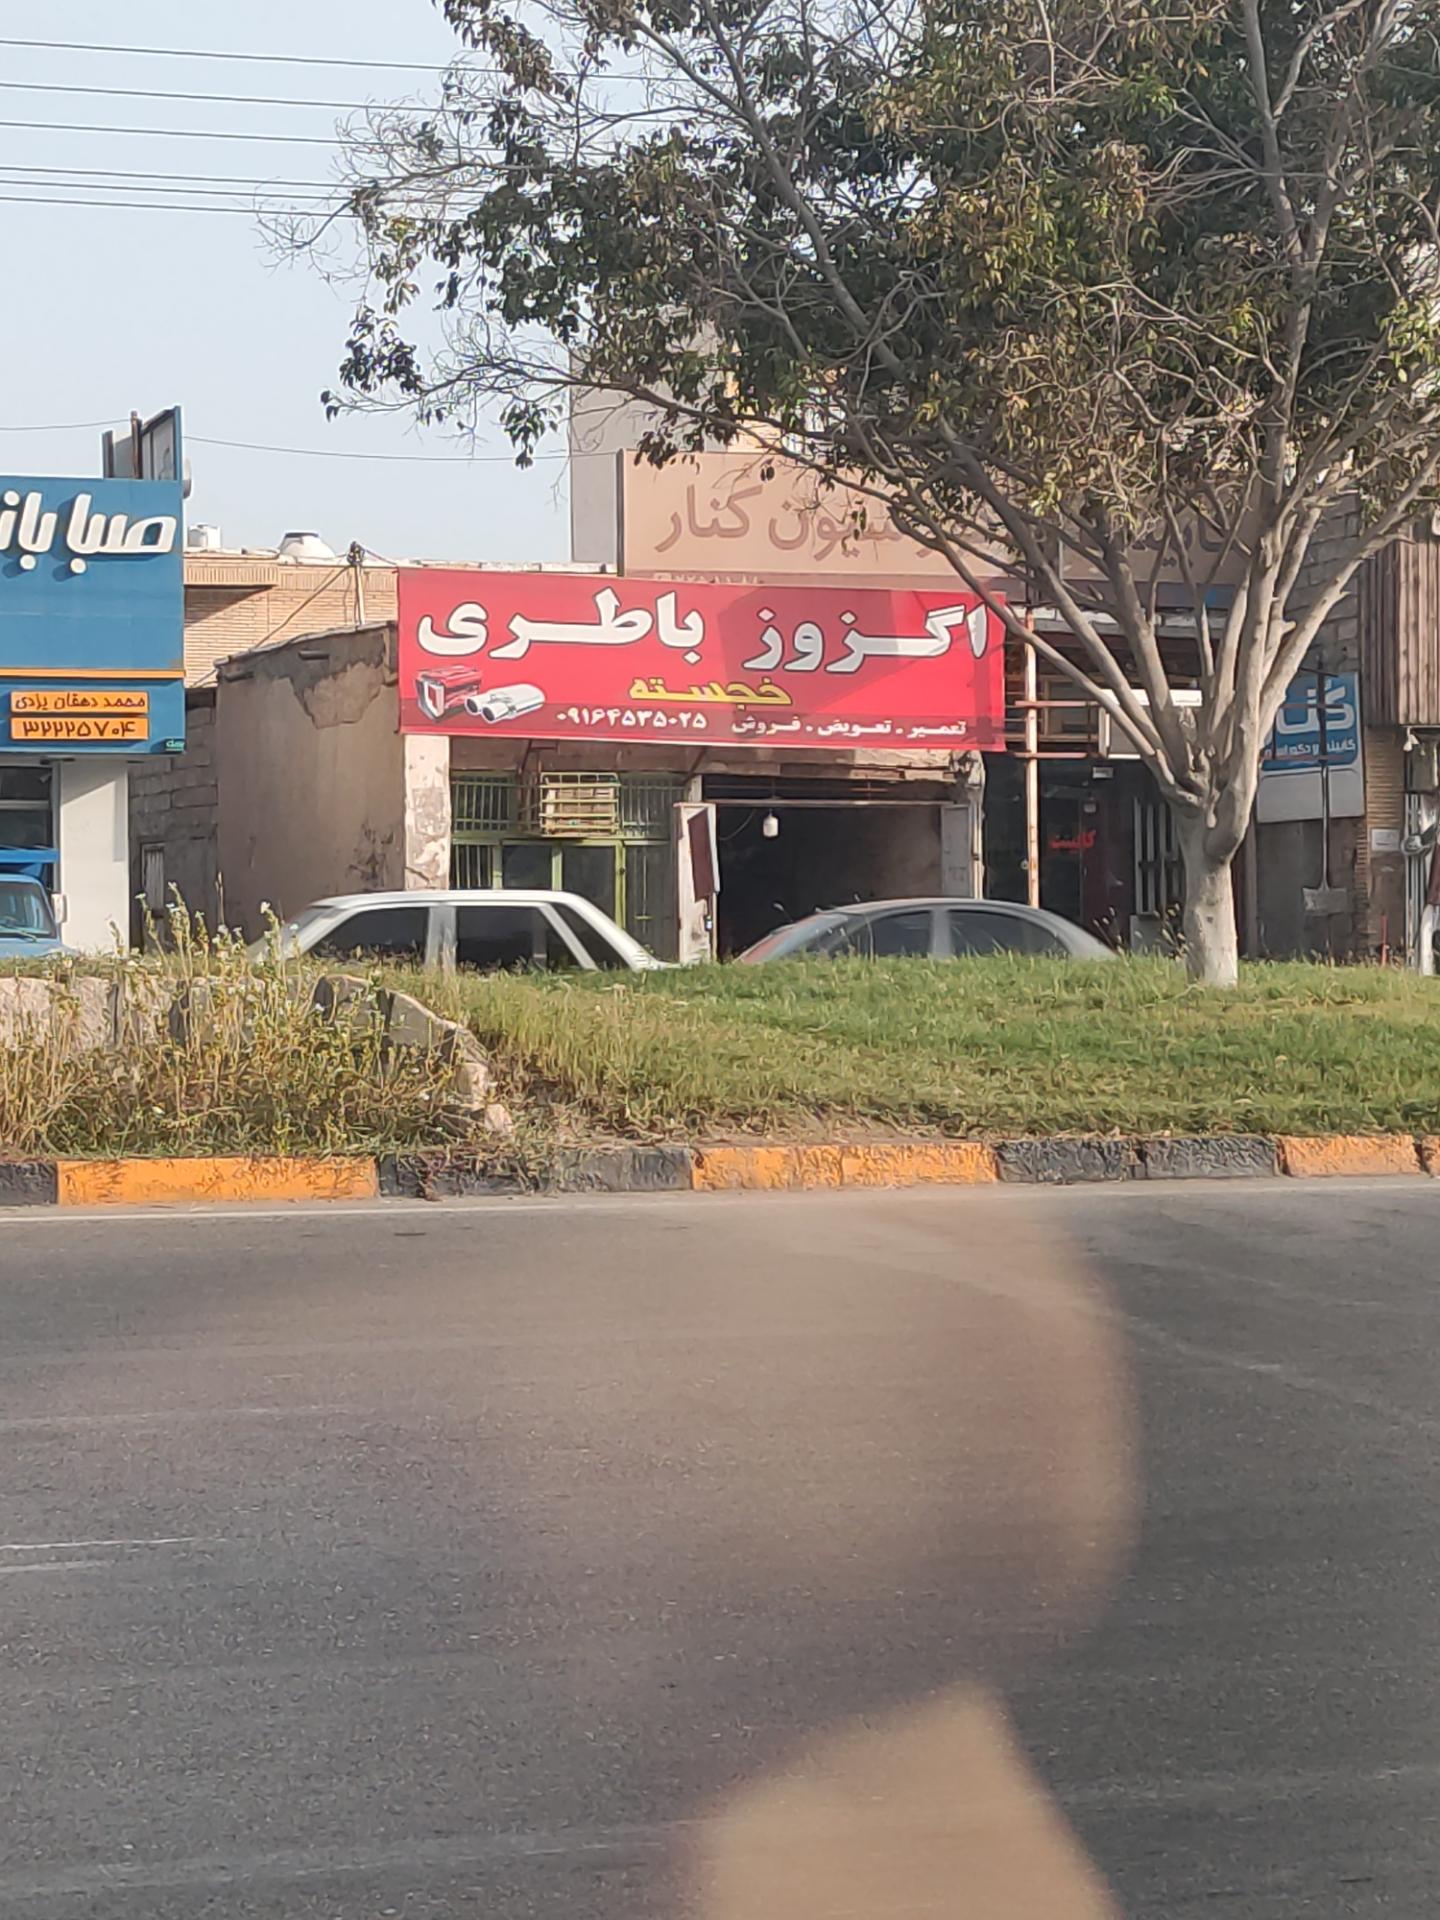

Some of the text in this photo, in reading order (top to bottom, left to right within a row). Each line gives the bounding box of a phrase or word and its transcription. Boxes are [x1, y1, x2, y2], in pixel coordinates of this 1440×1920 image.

[66, 492, 178, 575] صبا
[655, 484, 763, 554] کنار
[417, 586, 989, 674] اگزوز باطری
[15, 692, 146, 710] محمد دهقان یزدی
[629, 676, 793, 711] خجسته
[23, 720, 136, 738] ۳۲۲۲۵۷۰۴
[556, 706, 708, 730] ۰۹۱۶۴۵۳۵۰۲۵
[731, 715, 967, 739] تعمیر تعویض فروش
